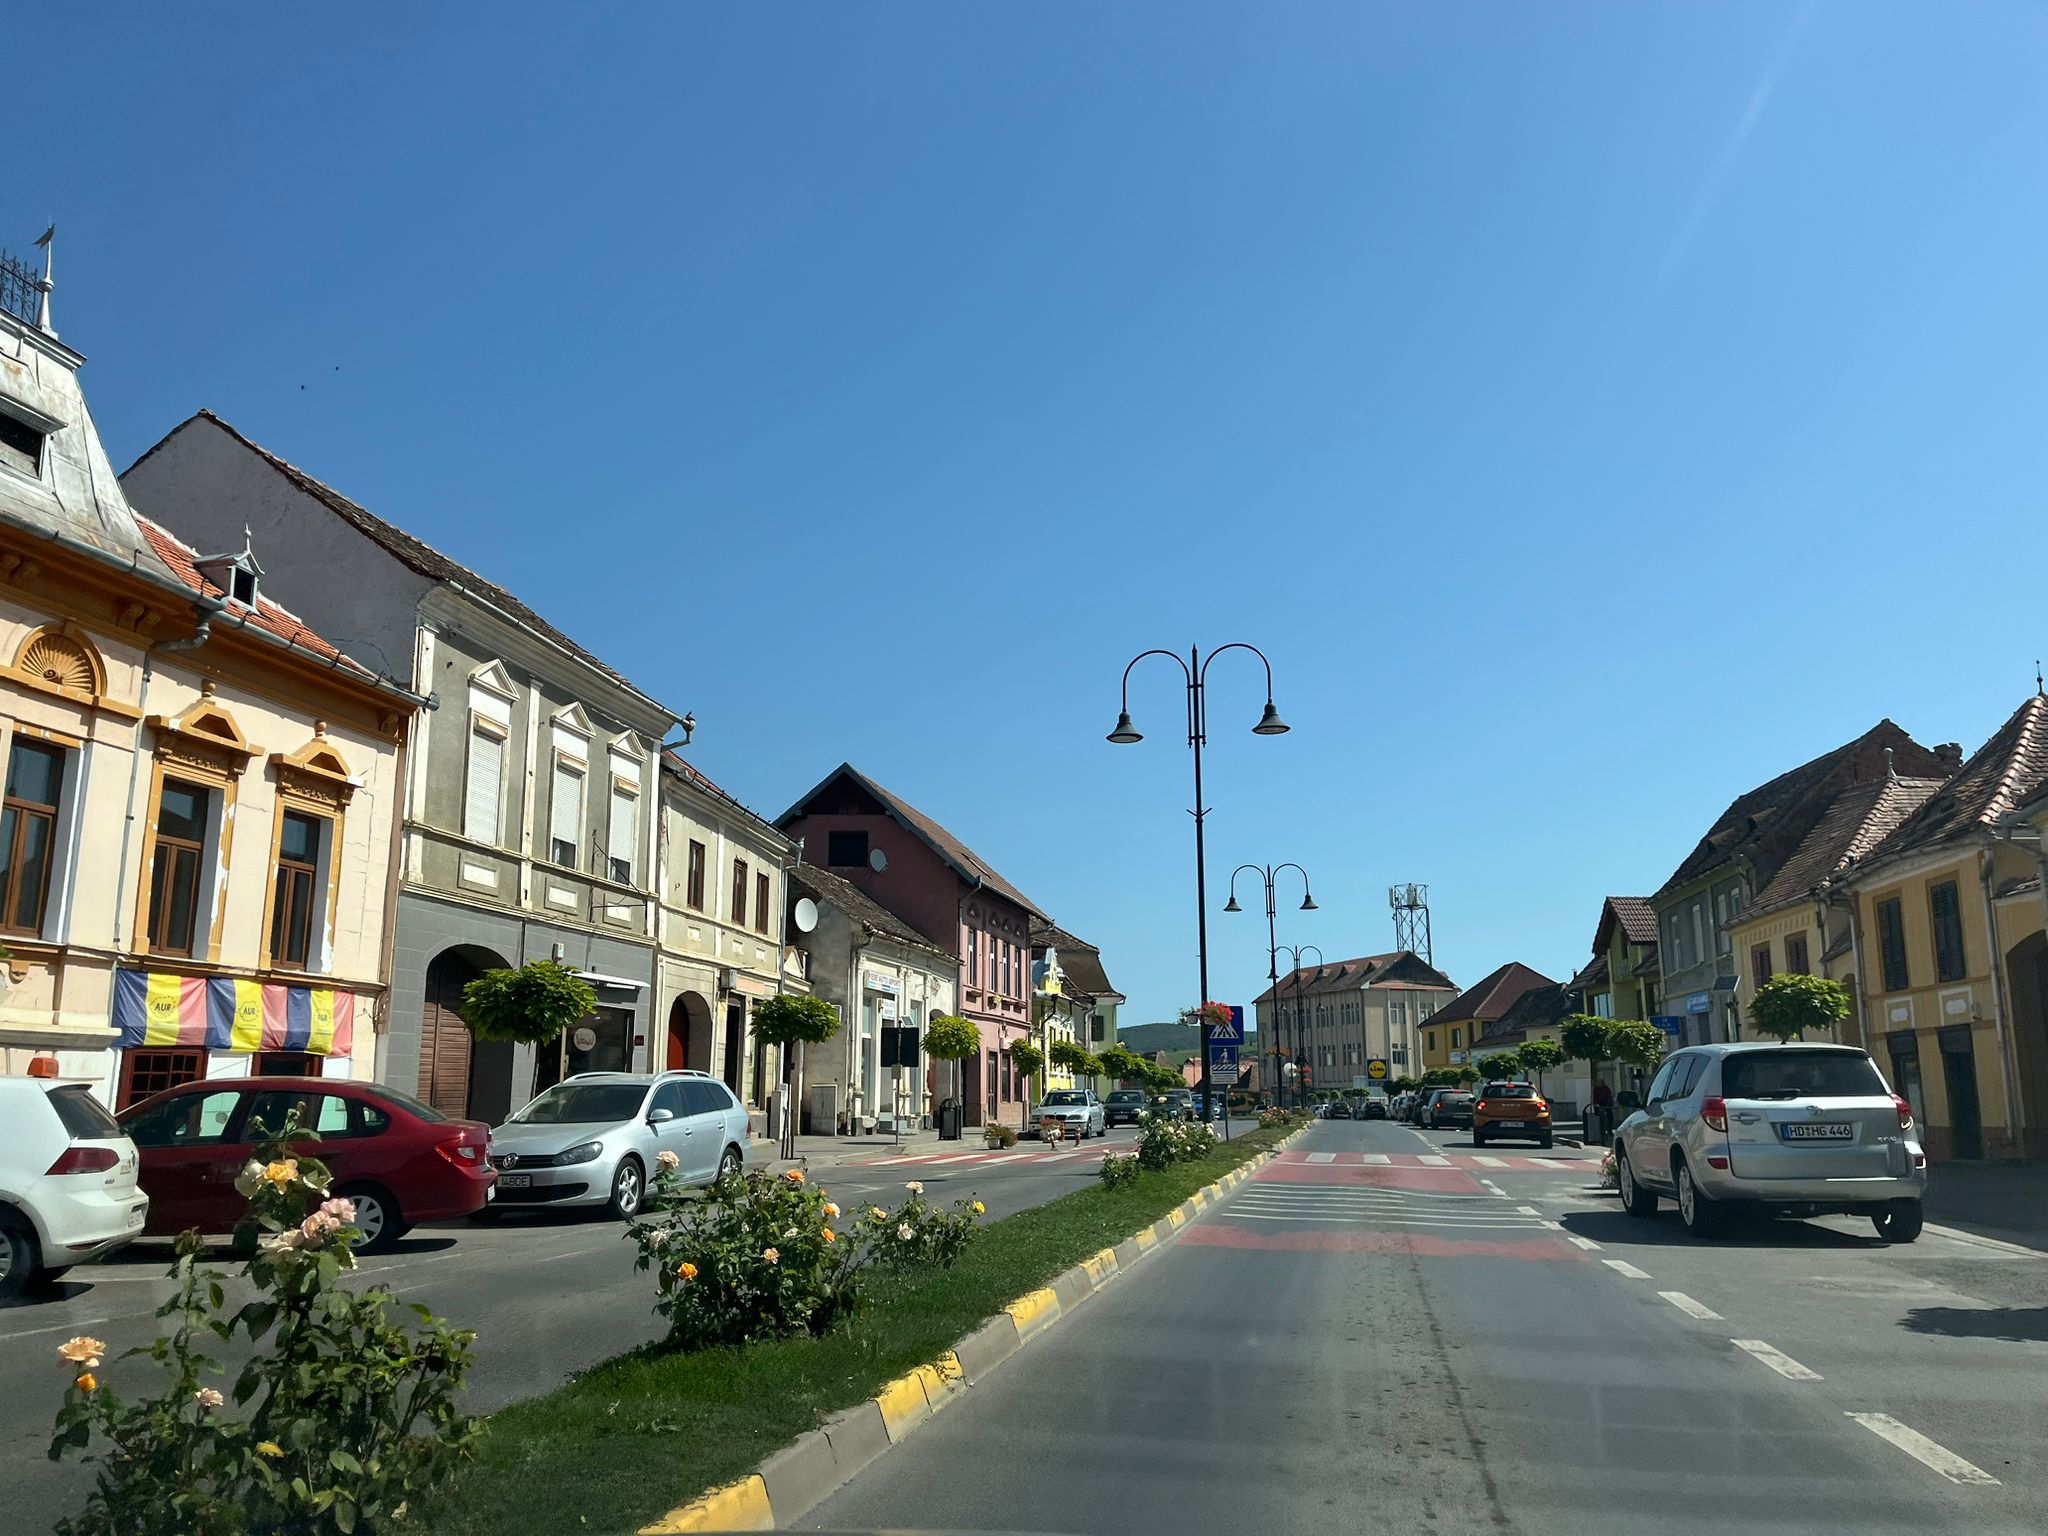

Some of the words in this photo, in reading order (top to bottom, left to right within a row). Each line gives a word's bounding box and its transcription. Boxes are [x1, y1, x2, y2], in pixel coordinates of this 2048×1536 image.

[154, 1002, 172, 1012] AUR
[242, 1006, 256, 1016] AUR
[1789, 1126, 1805, 1136] HD
[1811, 1126, 1827, 1136] HG
[1829, 1126, 1850, 1136] 446
